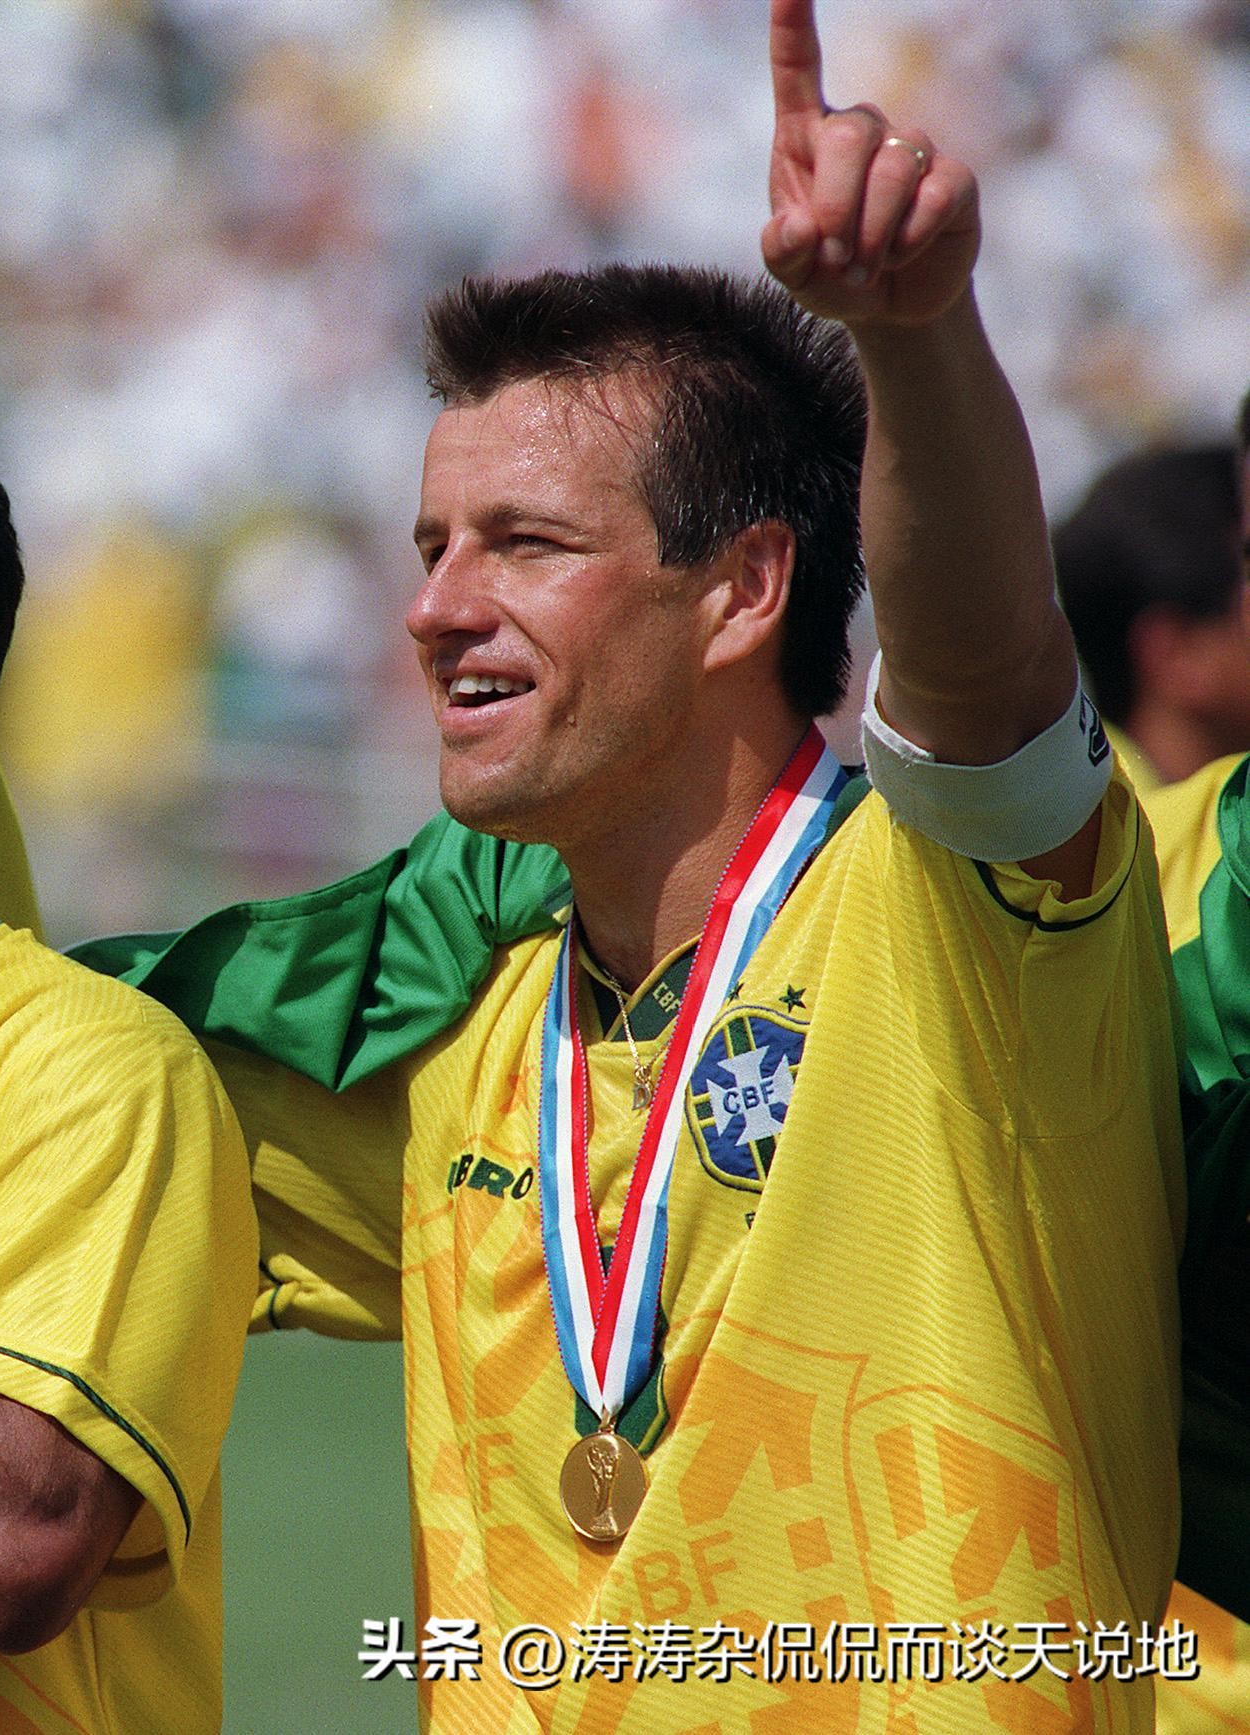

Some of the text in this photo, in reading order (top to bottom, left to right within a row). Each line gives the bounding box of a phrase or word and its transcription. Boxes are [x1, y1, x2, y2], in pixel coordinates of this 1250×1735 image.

[652, 981, 682, 1012] CBF
[723, 1079, 775, 1115] CBF
[447, 1154, 533, 1200] BRO
